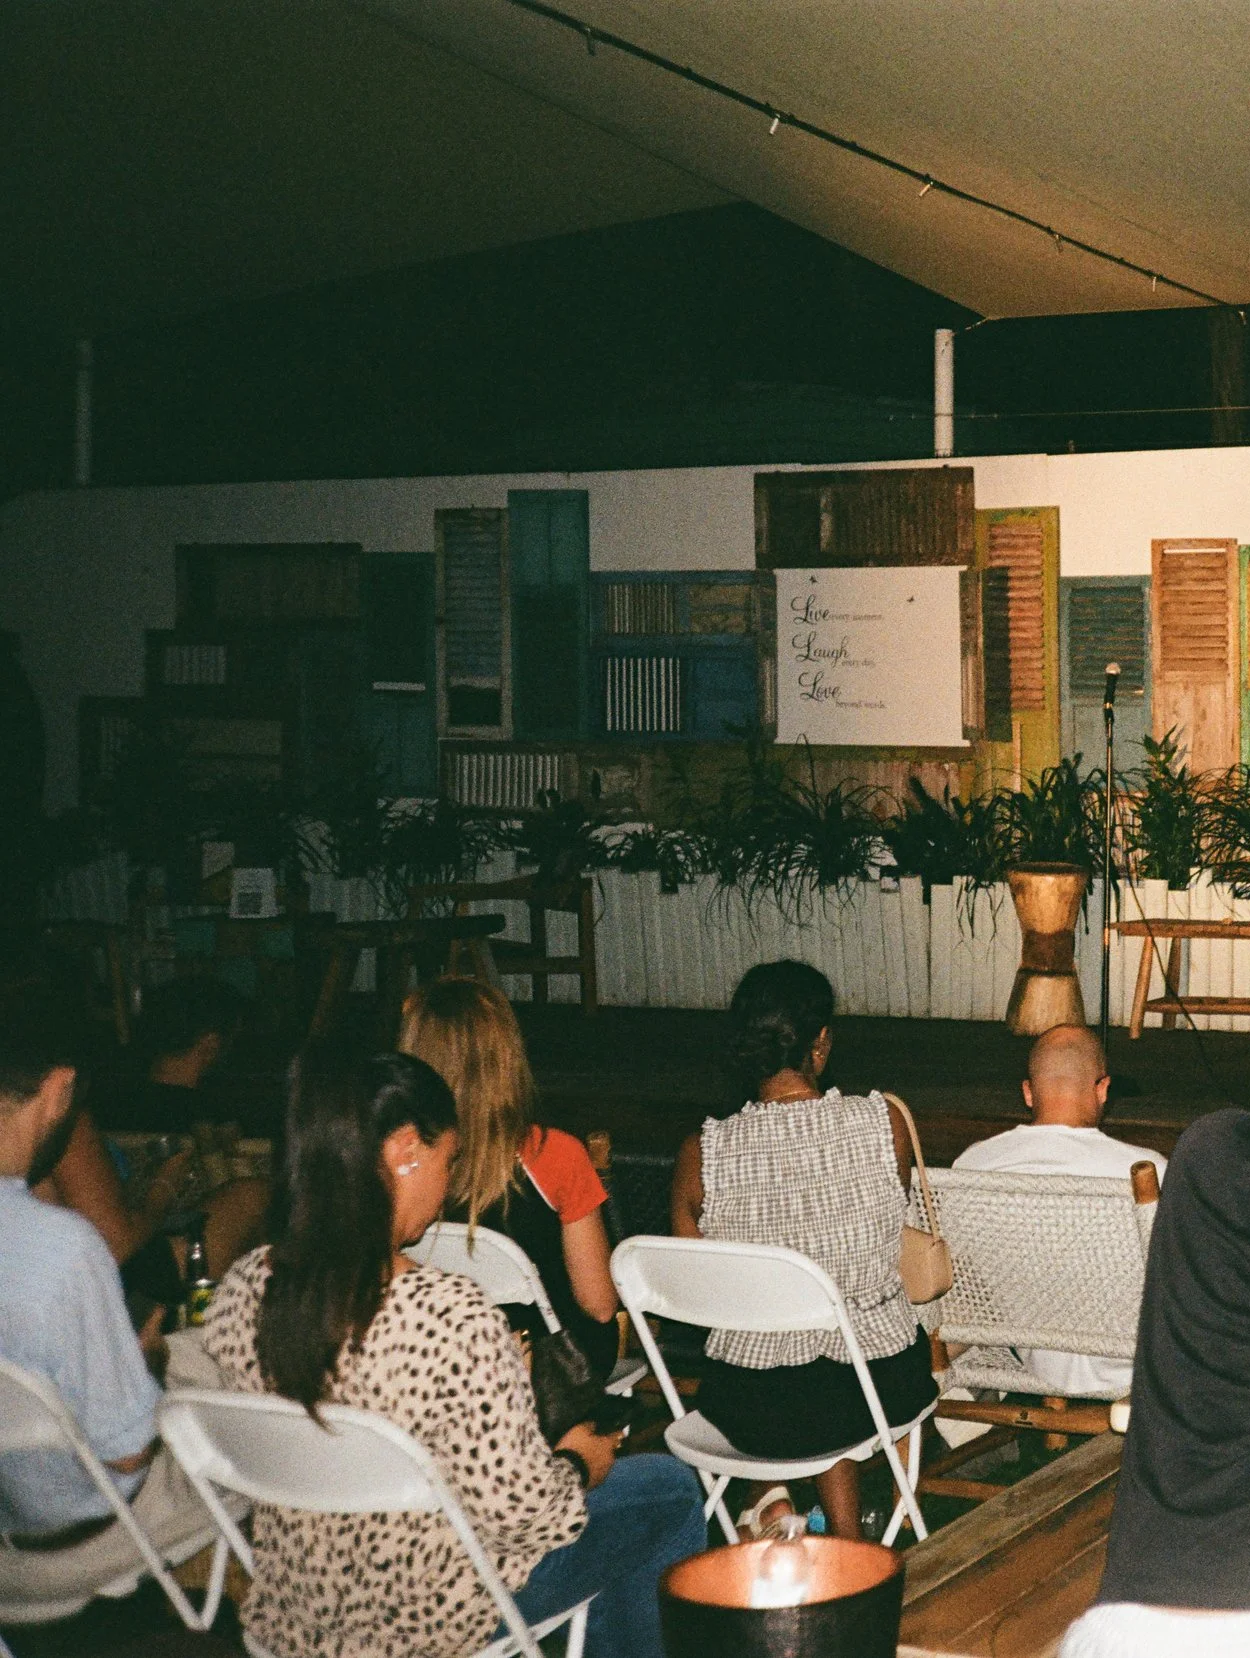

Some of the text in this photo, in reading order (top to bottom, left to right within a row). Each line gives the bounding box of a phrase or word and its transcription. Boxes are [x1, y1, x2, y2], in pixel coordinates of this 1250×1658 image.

[790, 594, 830, 625] Live
[791, 631, 849, 668] Laugh
[798, 670, 841, 703] Love
